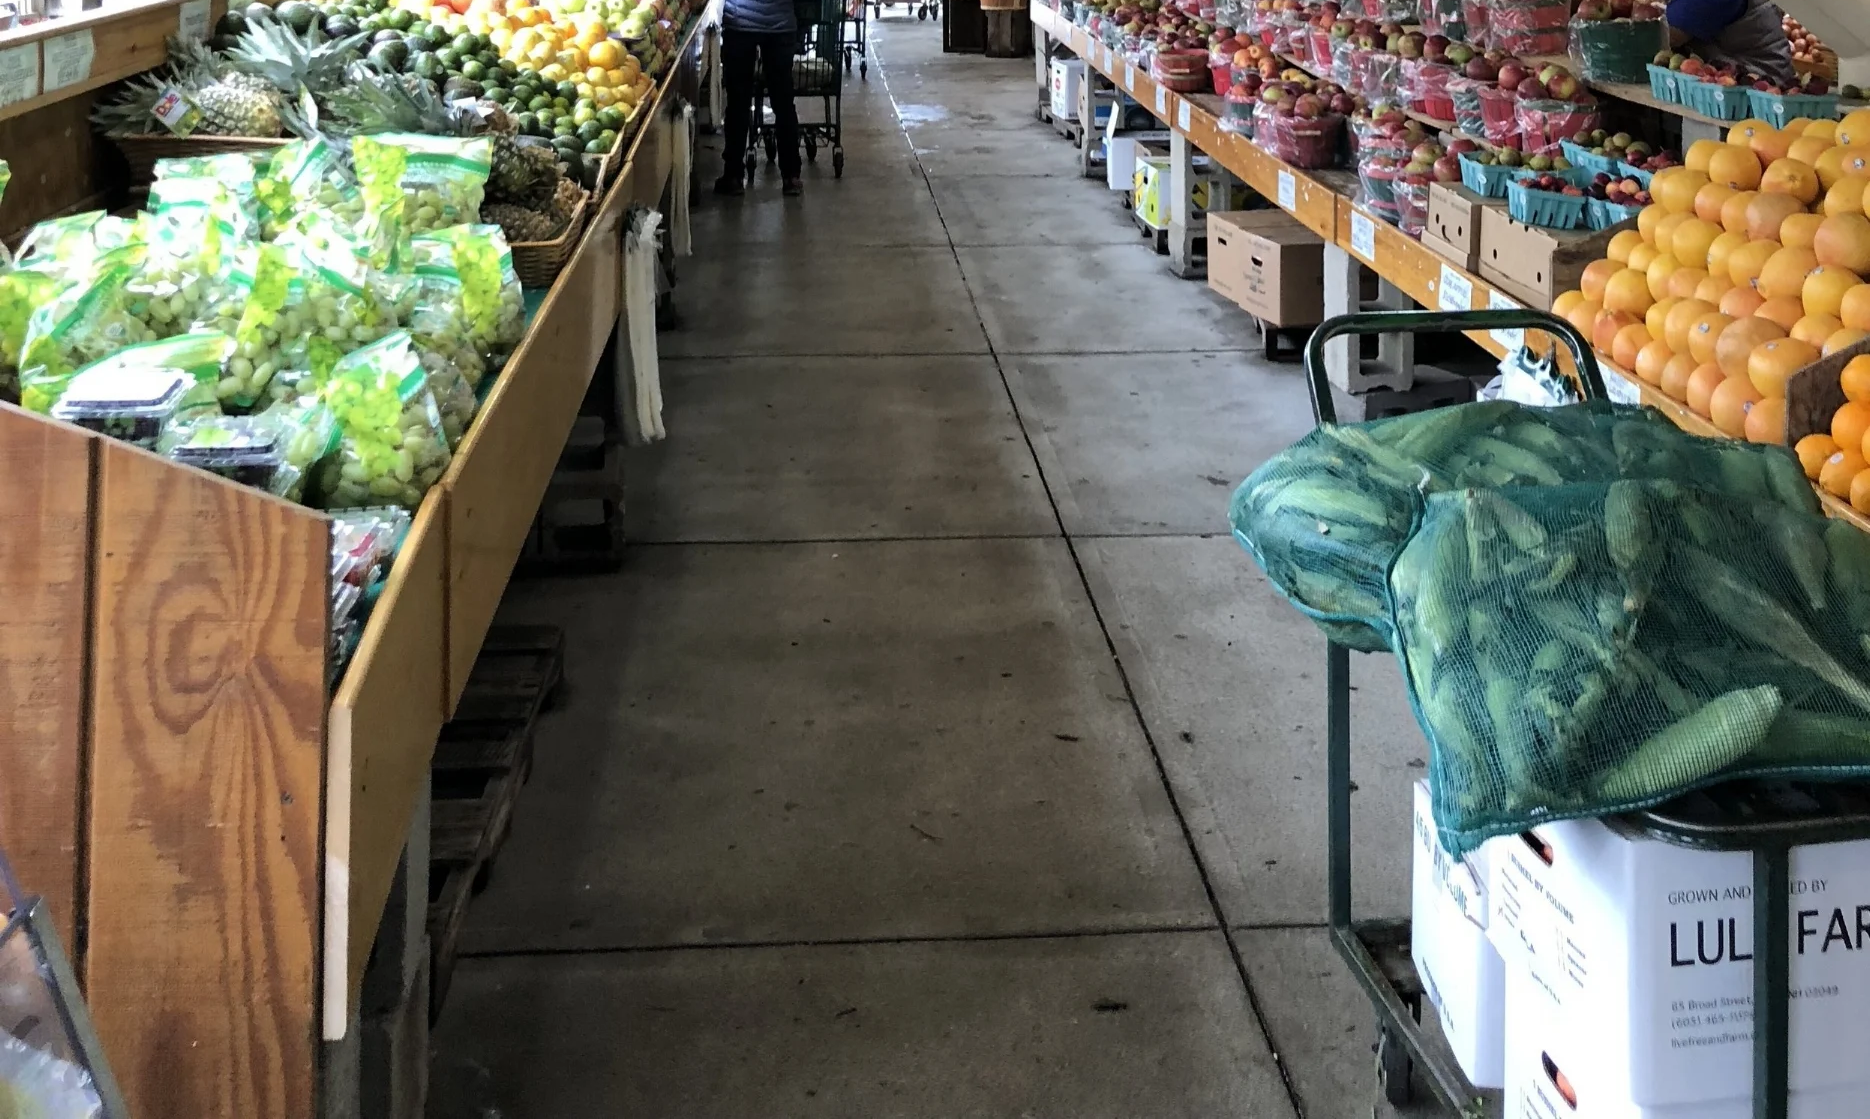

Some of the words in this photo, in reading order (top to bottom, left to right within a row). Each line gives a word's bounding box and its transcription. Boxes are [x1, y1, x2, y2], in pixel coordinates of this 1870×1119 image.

[1545, 890, 1575, 925] VOLUME
[1668, 888, 1718, 906] GROWN
[1722, 885, 1751, 900] AND
[1811, 879, 1828, 893] BY
[1670, 917, 1753, 967] LUL
[1797, 904, 1870, 955] FAR
